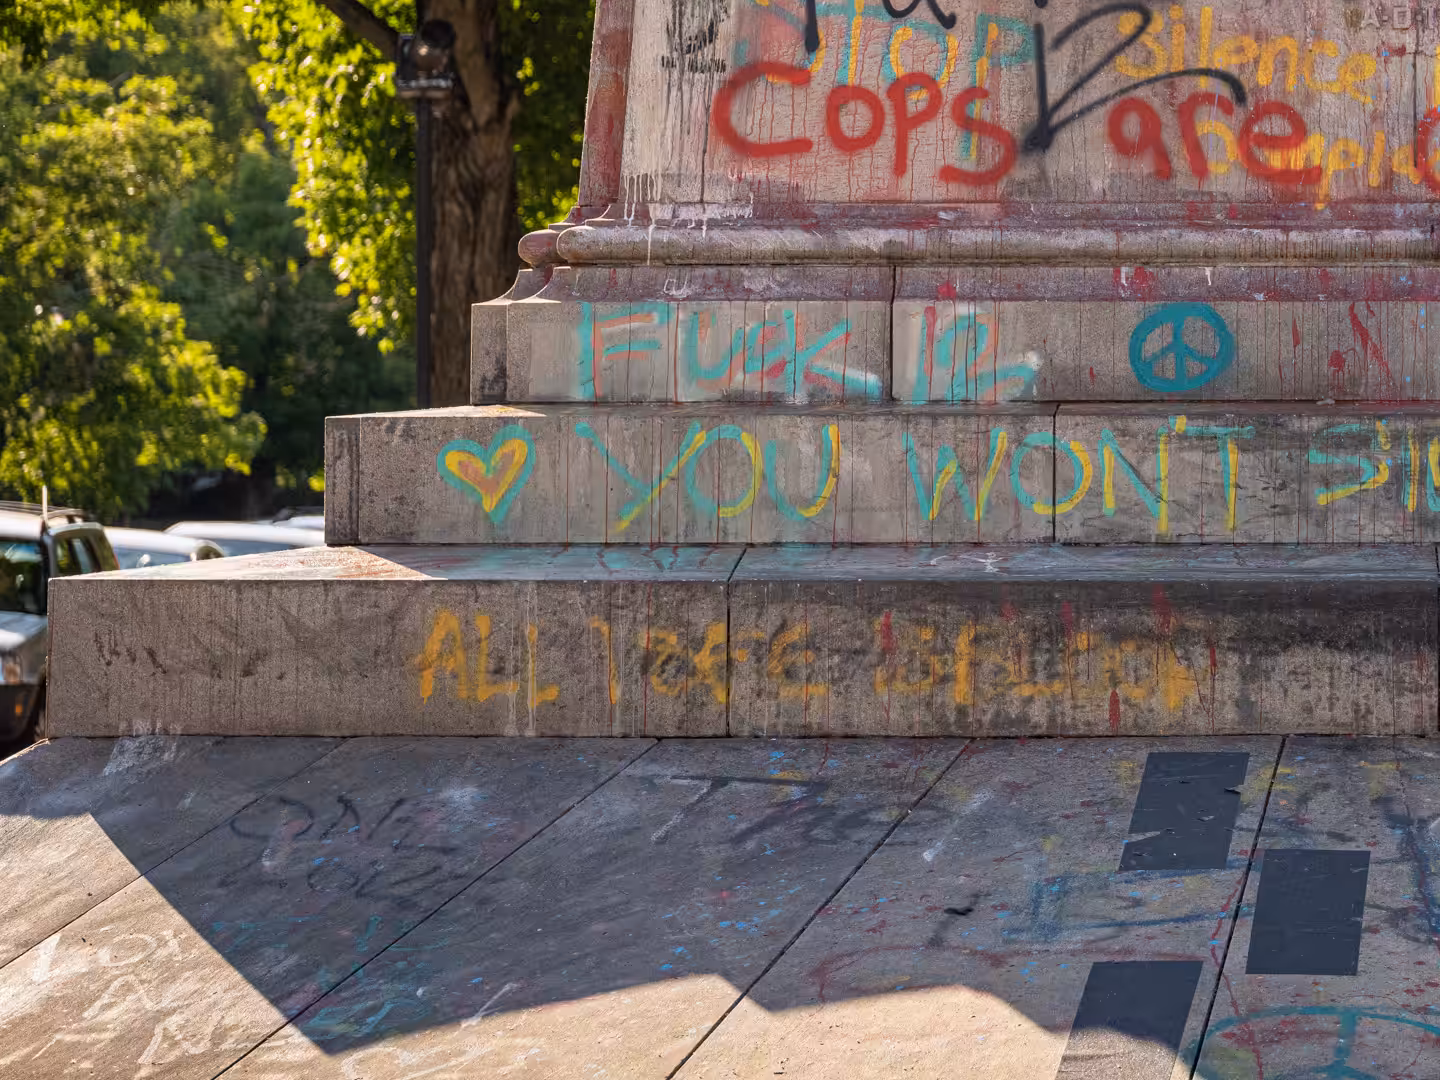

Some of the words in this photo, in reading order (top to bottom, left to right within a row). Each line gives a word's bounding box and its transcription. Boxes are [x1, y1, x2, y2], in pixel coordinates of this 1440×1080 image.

[577, 300, 886, 402] FUCK
[575, 422, 844, 534] YOU
[901, 414, 1257, 535] WON'T
[416, 609, 560, 710] ALL
